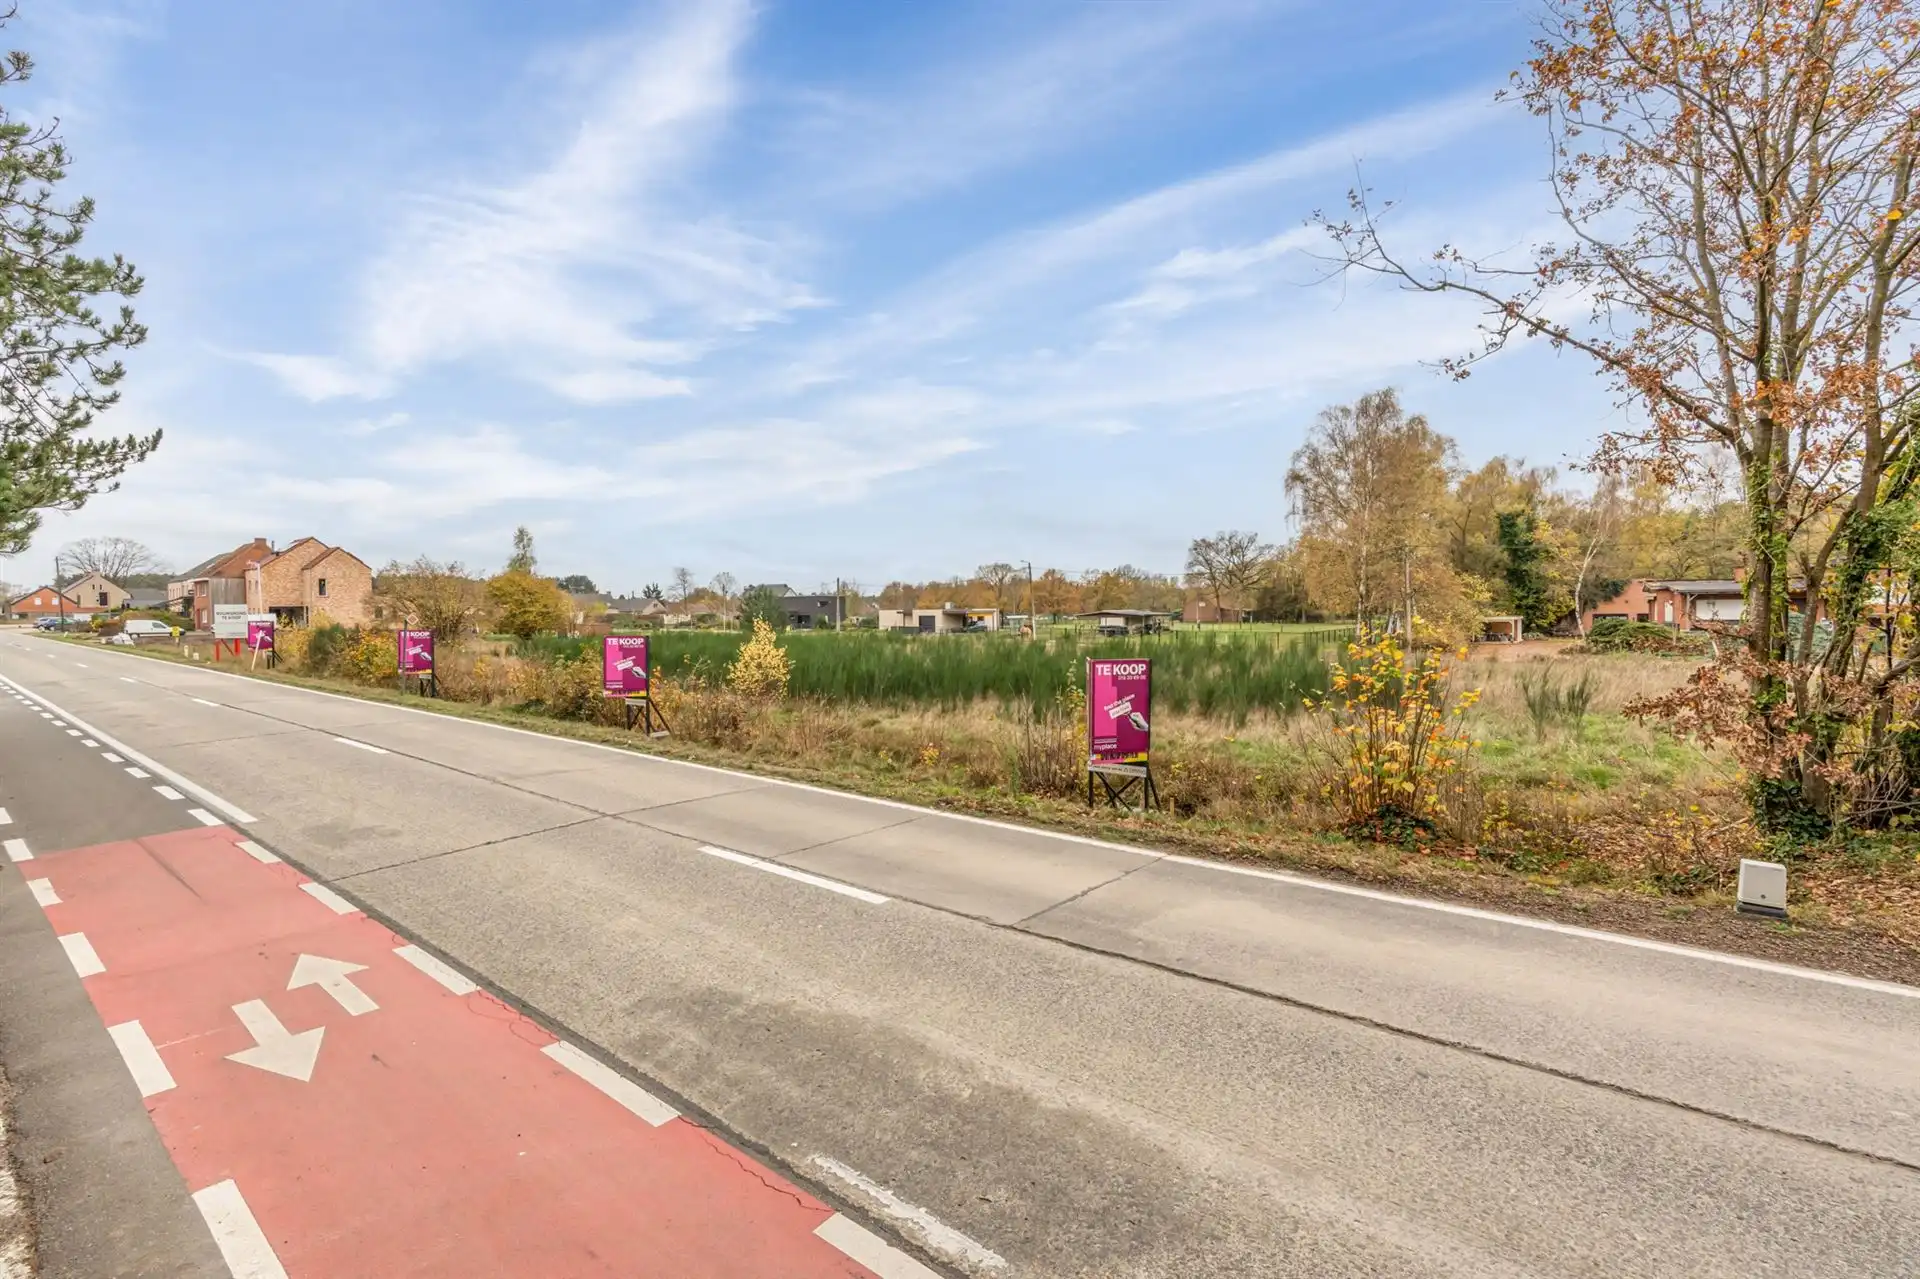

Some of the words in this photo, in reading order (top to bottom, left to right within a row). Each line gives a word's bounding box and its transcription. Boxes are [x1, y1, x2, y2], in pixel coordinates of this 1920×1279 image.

[607, 637, 619, 645] TE
[619, 637, 644, 645] KOOP
[1096, 664, 1112, 676] TE
[1113, 664, 1147, 676] KOOP
